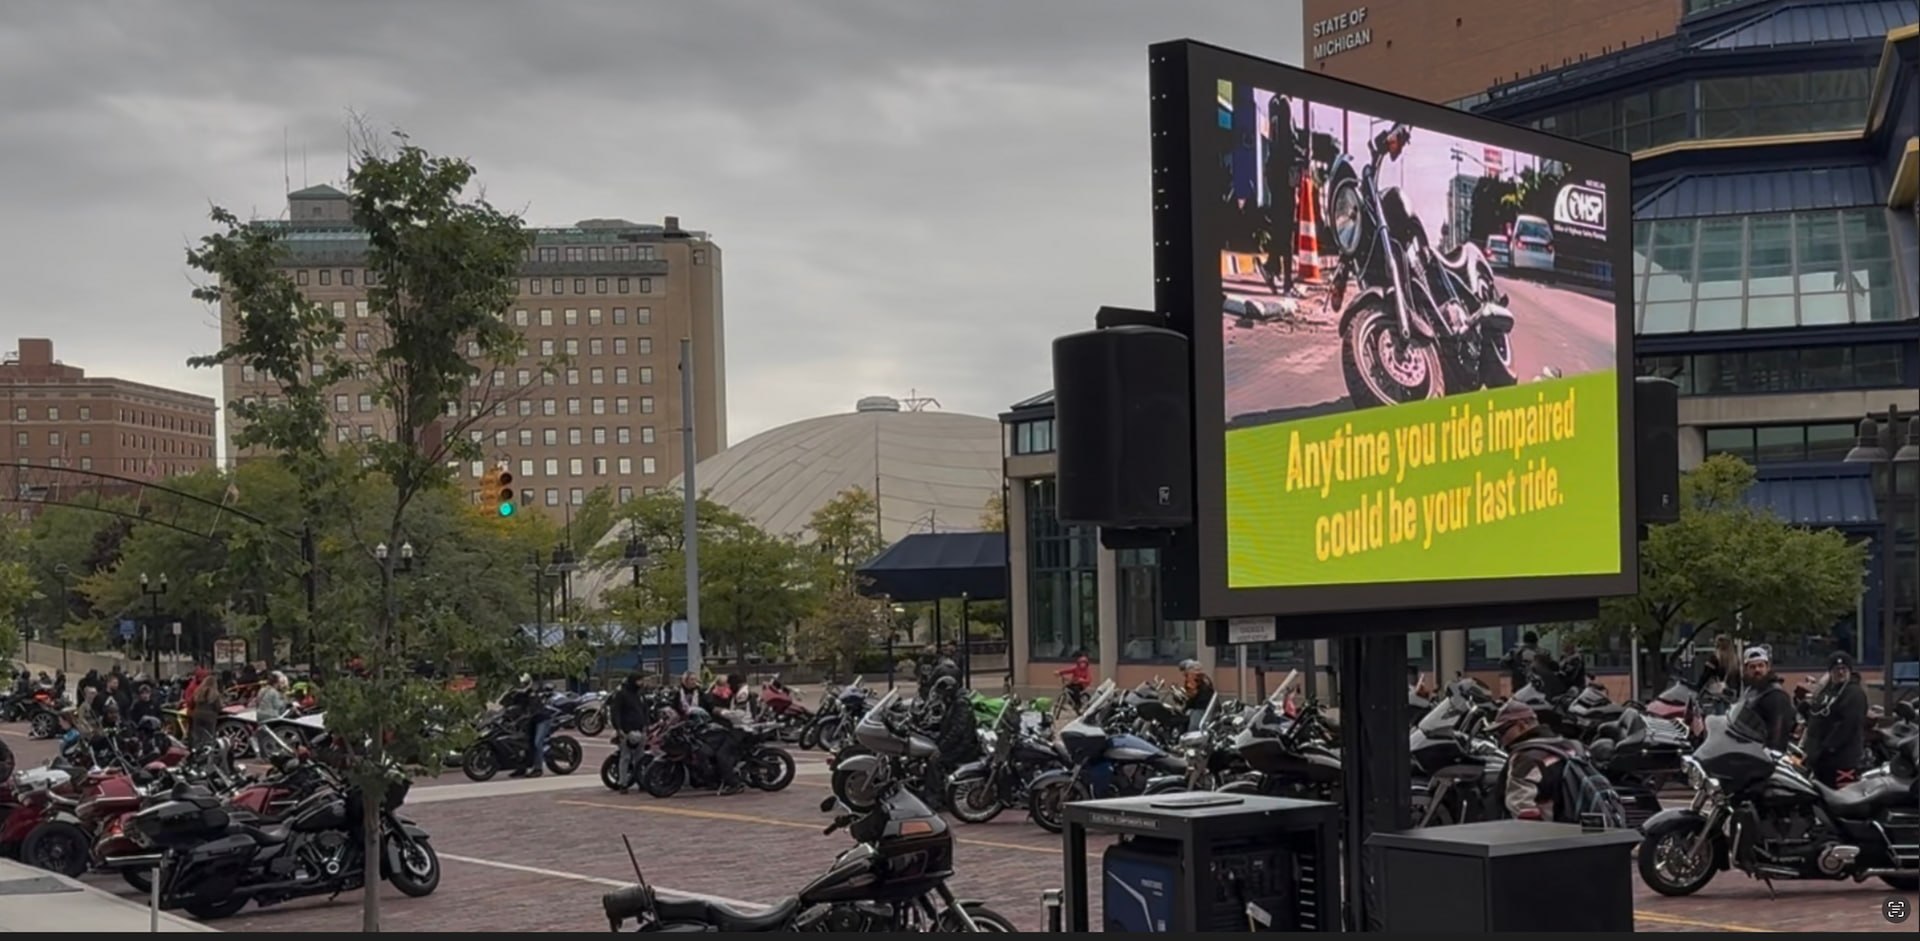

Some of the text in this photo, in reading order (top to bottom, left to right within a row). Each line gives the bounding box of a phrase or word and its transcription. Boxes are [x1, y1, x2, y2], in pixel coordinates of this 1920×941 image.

[1313, 6, 1367, 38] STATE OF
[1313, 28, 1371, 60] MICHIGAN
[1286, 388, 1576, 498] Anytime you ride impaired
[1315, 457, 1563, 561] could be your last ride.
